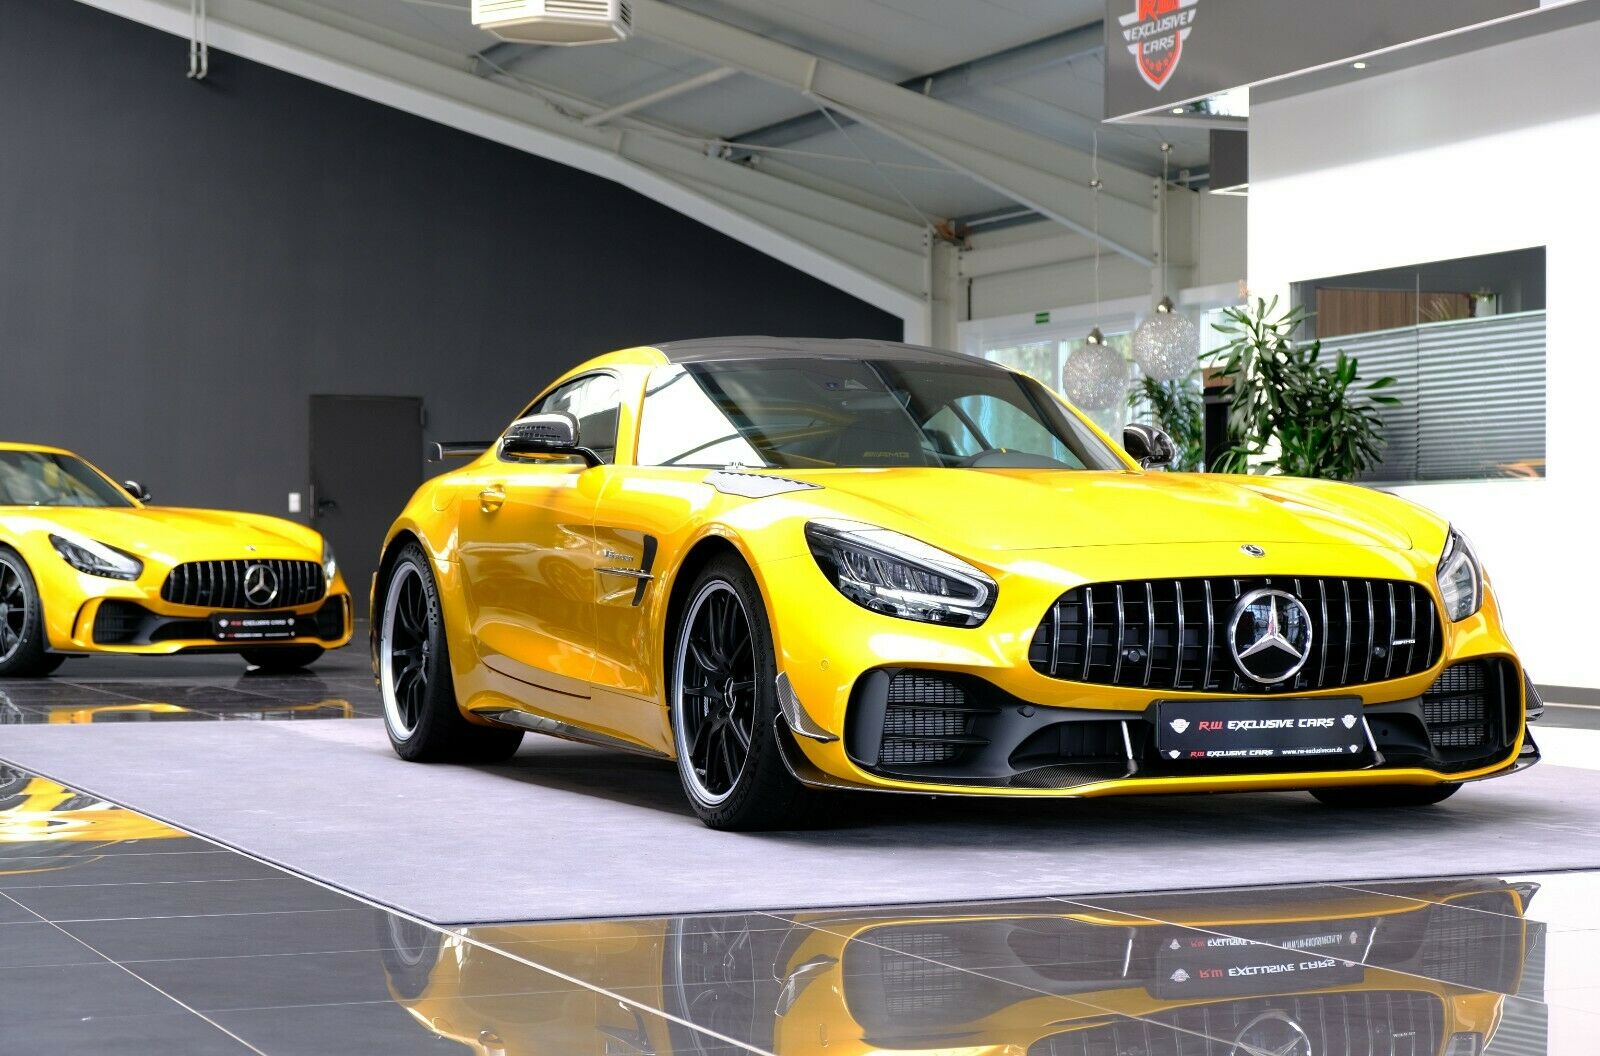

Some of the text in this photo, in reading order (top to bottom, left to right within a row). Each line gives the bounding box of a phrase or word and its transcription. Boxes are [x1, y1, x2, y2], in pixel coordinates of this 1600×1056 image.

[1131, 11, 1188, 40] EXCLUSIVE
[1143, 35, 1175, 54] CARS
[1227, 719, 1294, 731] EXCLUSIVE
[1298, 718, 1335, 728] CARS
